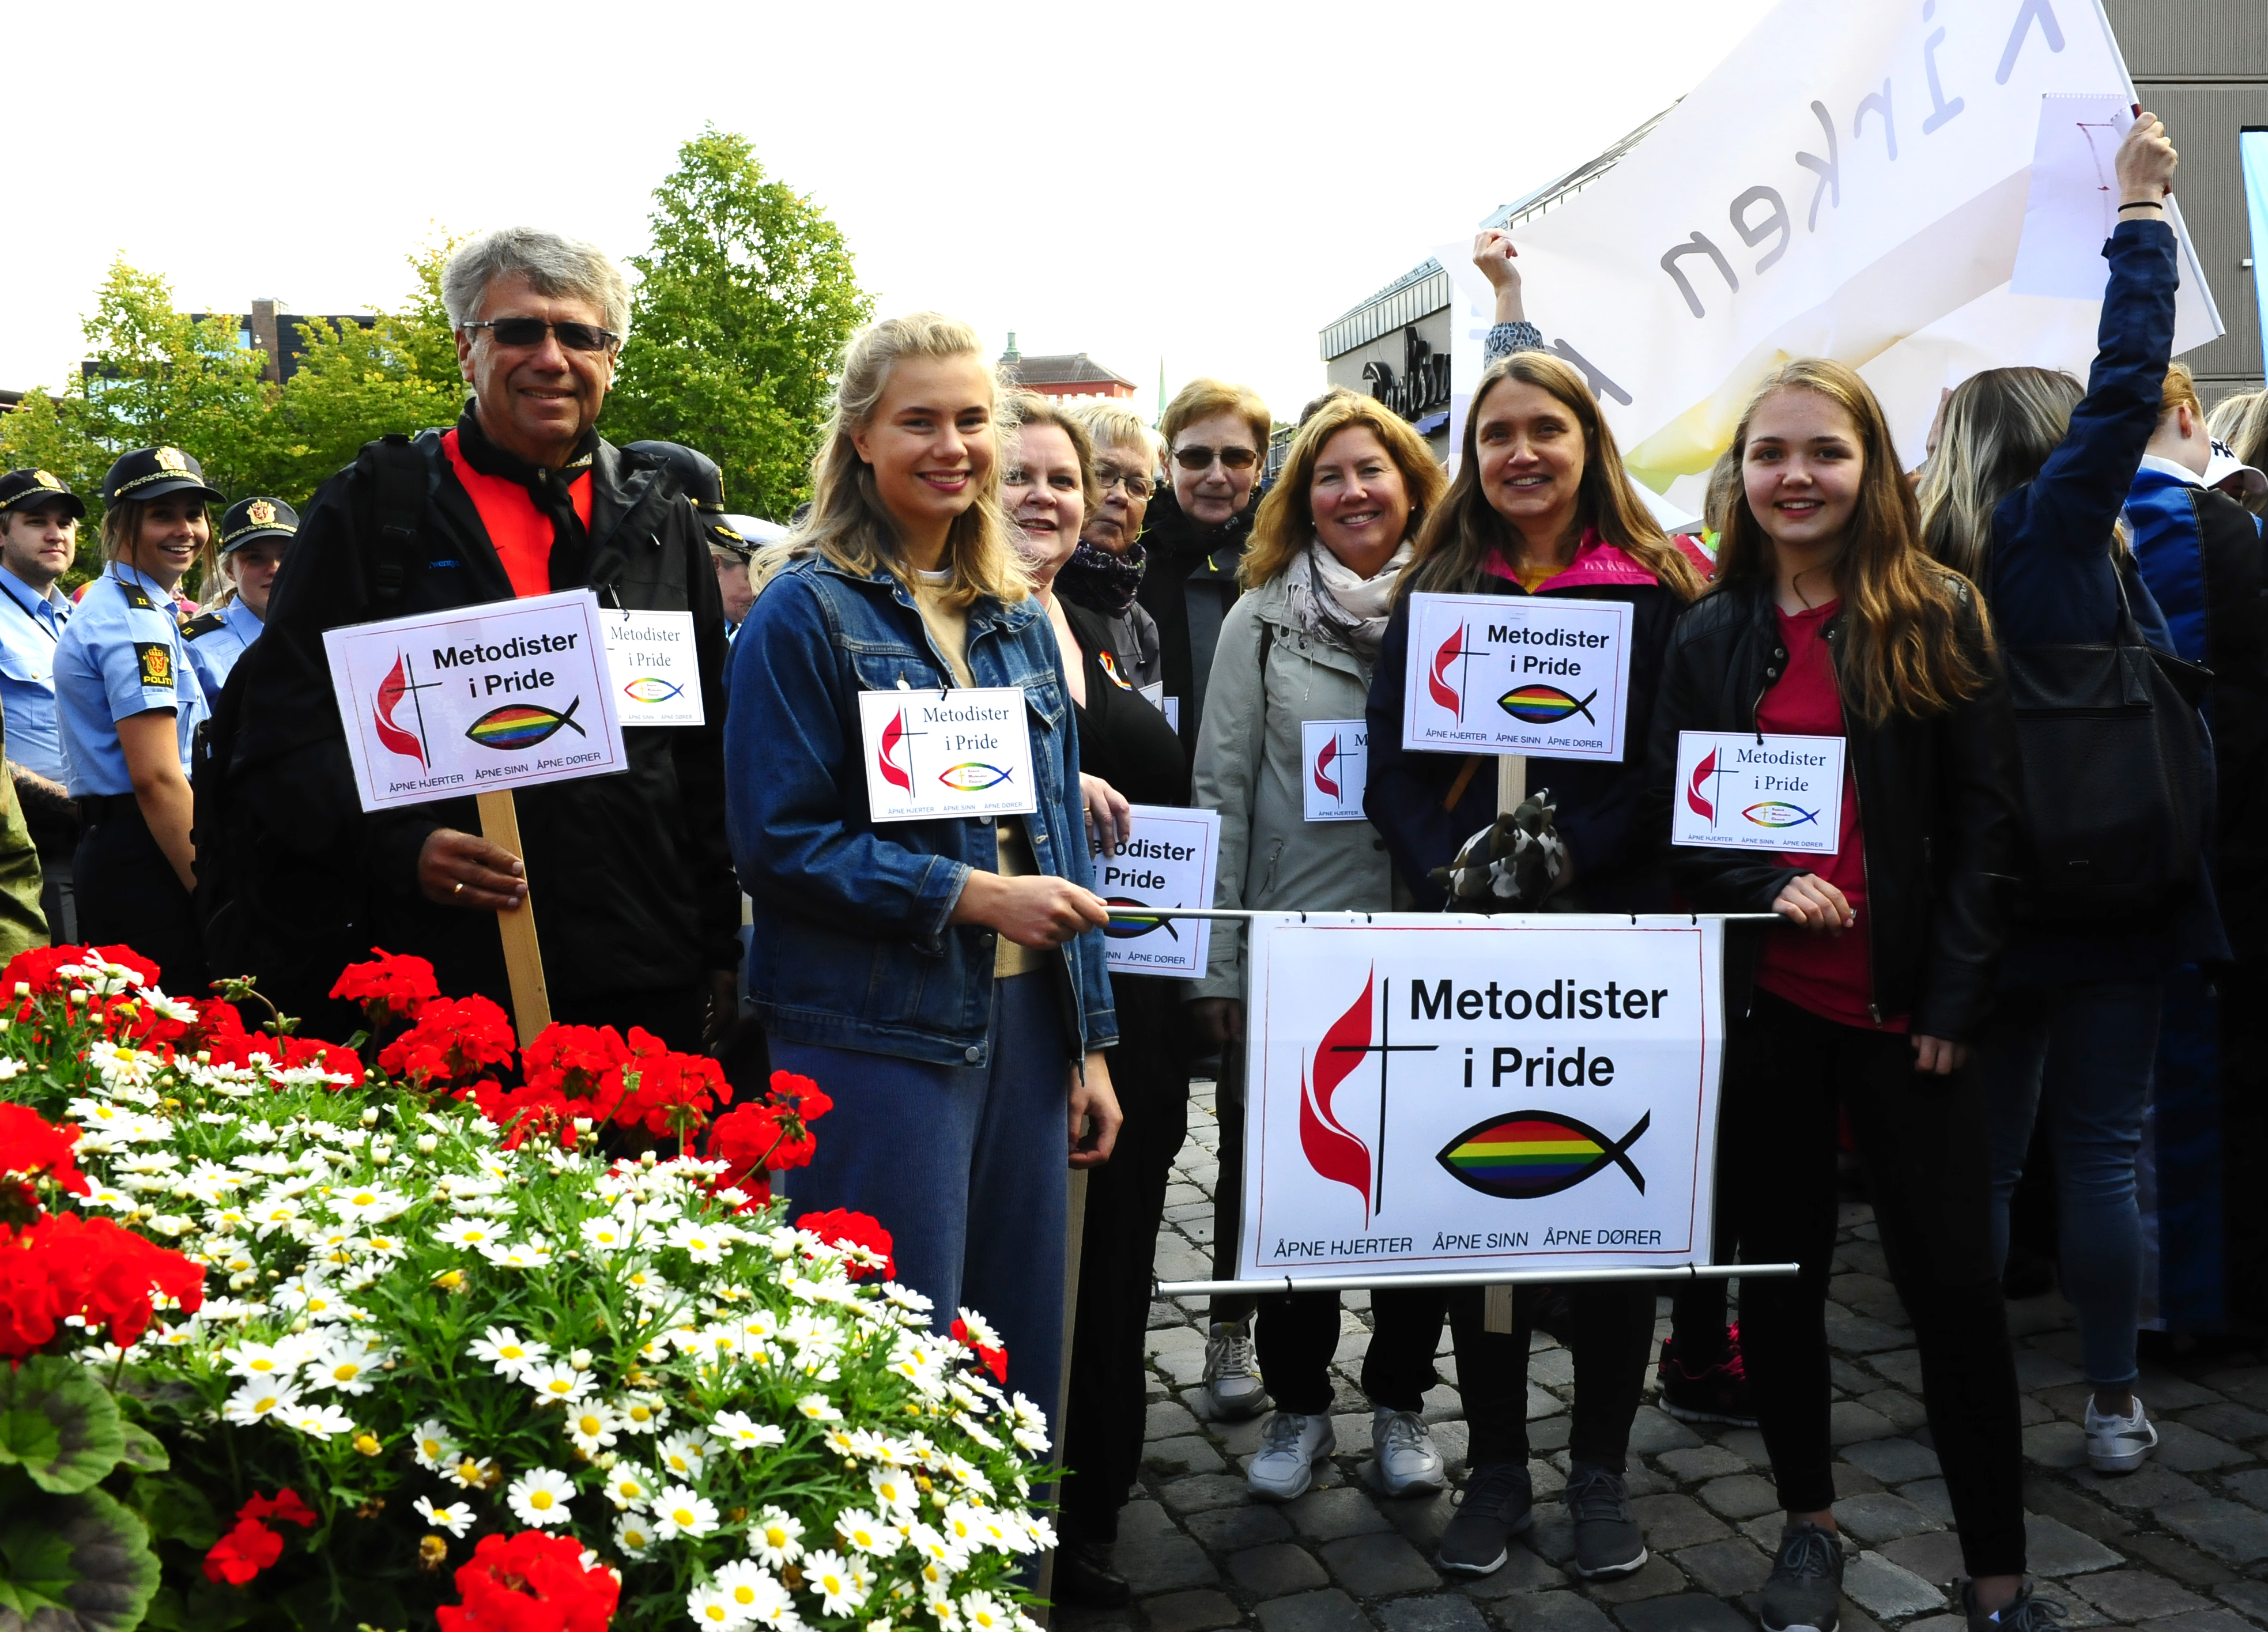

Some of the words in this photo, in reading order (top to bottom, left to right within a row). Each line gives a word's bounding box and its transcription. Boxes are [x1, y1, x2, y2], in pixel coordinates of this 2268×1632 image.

[610, 626, 680, 641] Metodister
[1488, 625, 1609, 649] Metodister
[433, 632, 578, 670] Metodister
[628, 652, 633, 666] i
[637, 652, 671, 666] Pride
[1510, 655, 1515, 673] i
[1523, 655, 1582, 677] Pride
[144, 675, 172, 686] POLITI
[469, 678, 477, 698] i
[485, 668, 555, 698] Pride
[923, 705, 1009, 723] Metodister
[946, 736, 950, 750] i
[955, 734, 998, 750] Pride
[1425, 728, 1448, 739] ÅPNE
[1450, 730, 1487, 741] HJERTER
[1496, 732, 1519, 743] ÅPNE
[1520, 734, 1541, 744] SINN
[1547, 736, 1571, 747] ÅPNE
[1572, 738, 1602, 748] DØRER
[1736, 749, 1827, 766] Metodister
[389, 780, 417, 793] ÅPNE
[418, 774, 464, 788] HJERTER
[475, 767, 503, 780] ÅPNE
[504, 764, 529, 776] SINN
[537, 758, 564, 770] ÅPNE
[565, 752, 601, 766] DØRER
[1754, 776, 1759, 789] i
[1765, 776, 1809, 792] Pride
[888, 806, 904, 814] ÅPNE
[1093, 838, 1195, 862] eodister
[1104, 867, 1165, 890] Pride
[1105, 951, 1121, 959] INN
[1127, 951, 1152, 962] ÅPNE
[1154, 954, 1186, 965] DØRER
[1411, 979, 1669, 1020] Metodister
[1464, 1047, 1473, 1088] i
[1492, 1047, 1615, 1088] Pride
[1274, 1238, 1325, 1258] ÅPNE
[1330, 1237, 1413, 1256] HJERTER
[1432, 1231, 1482, 1251] ÅPNE
[1486, 1231, 1529, 1249] SINN
[1543, 1227, 1592, 1246] ÅPNE
[1597, 1229, 1662, 1246] DØRER
